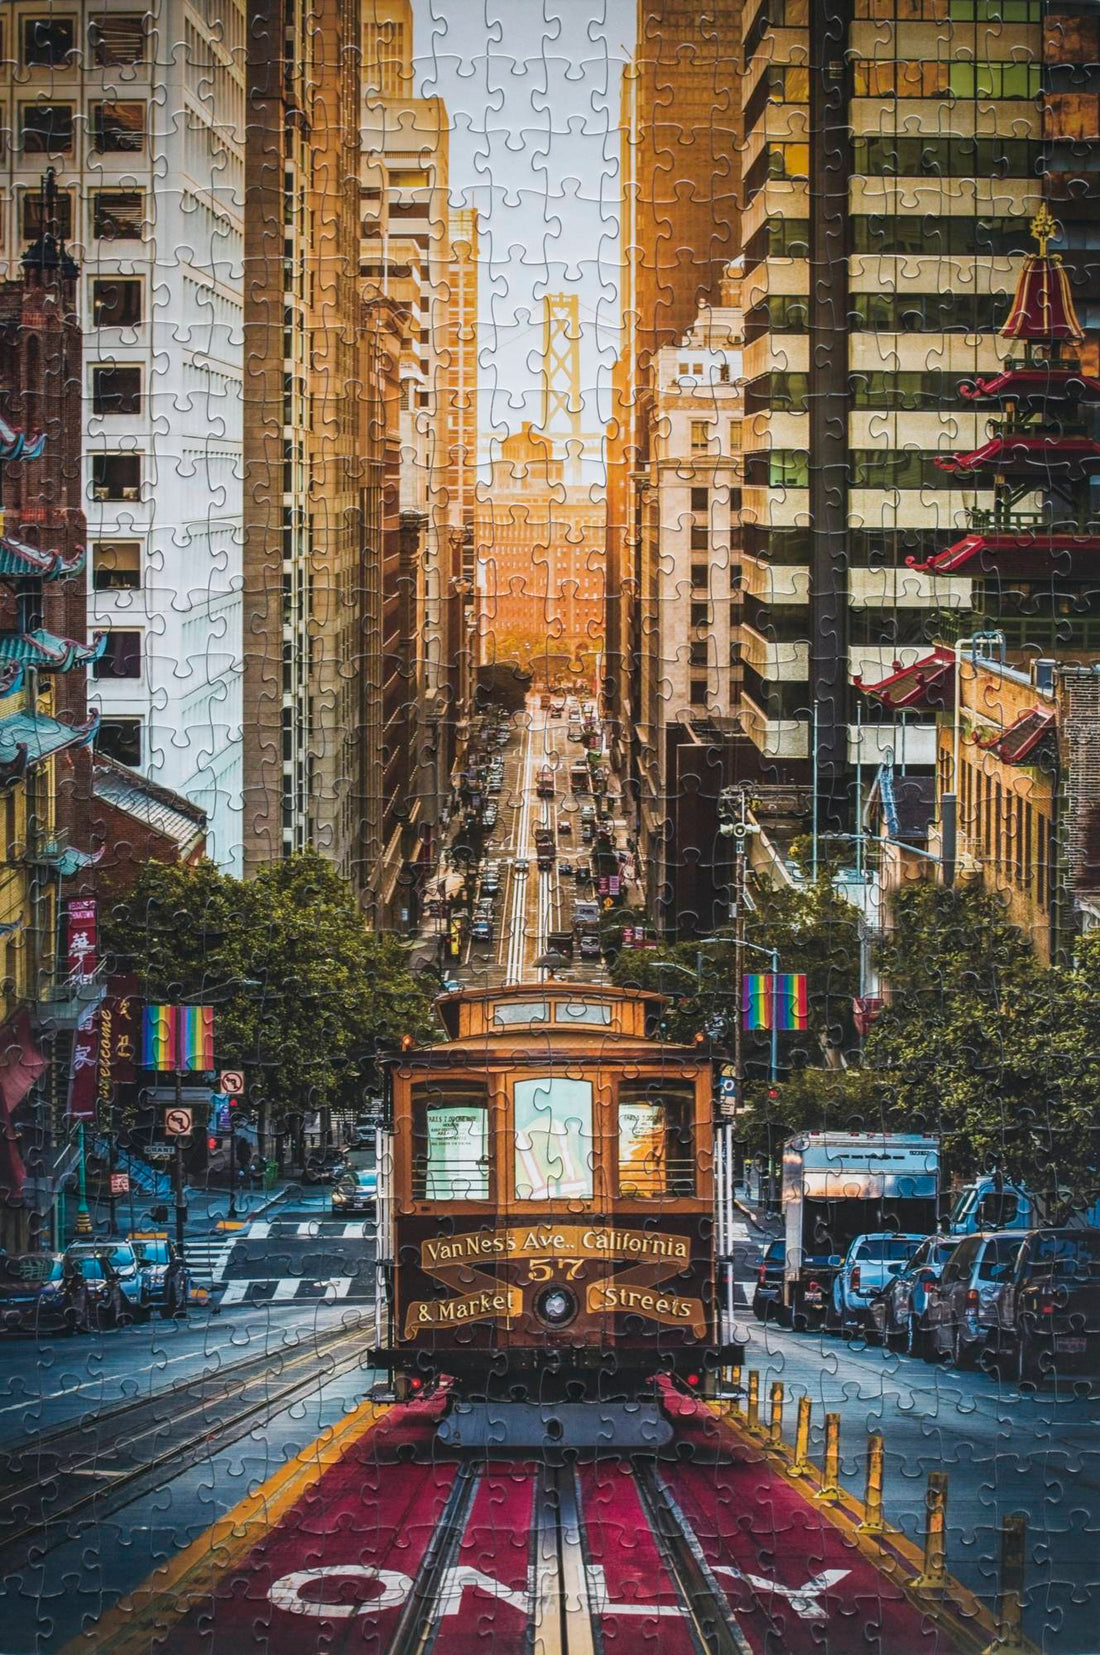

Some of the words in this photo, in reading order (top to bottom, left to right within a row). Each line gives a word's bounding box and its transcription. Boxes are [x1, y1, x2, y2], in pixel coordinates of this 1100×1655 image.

[428, 1242, 463, 1261] Van
[465, 1234, 515, 1255] Ness
[583, 1230, 688, 1258] California
[528, 1258, 584, 1281] 57
[418, 1304, 433, 1322] &
[439, 1290, 514, 1320] Market
[604, 1288, 691, 1317] Streets
[266, 1563, 853, 1619] ONLY
